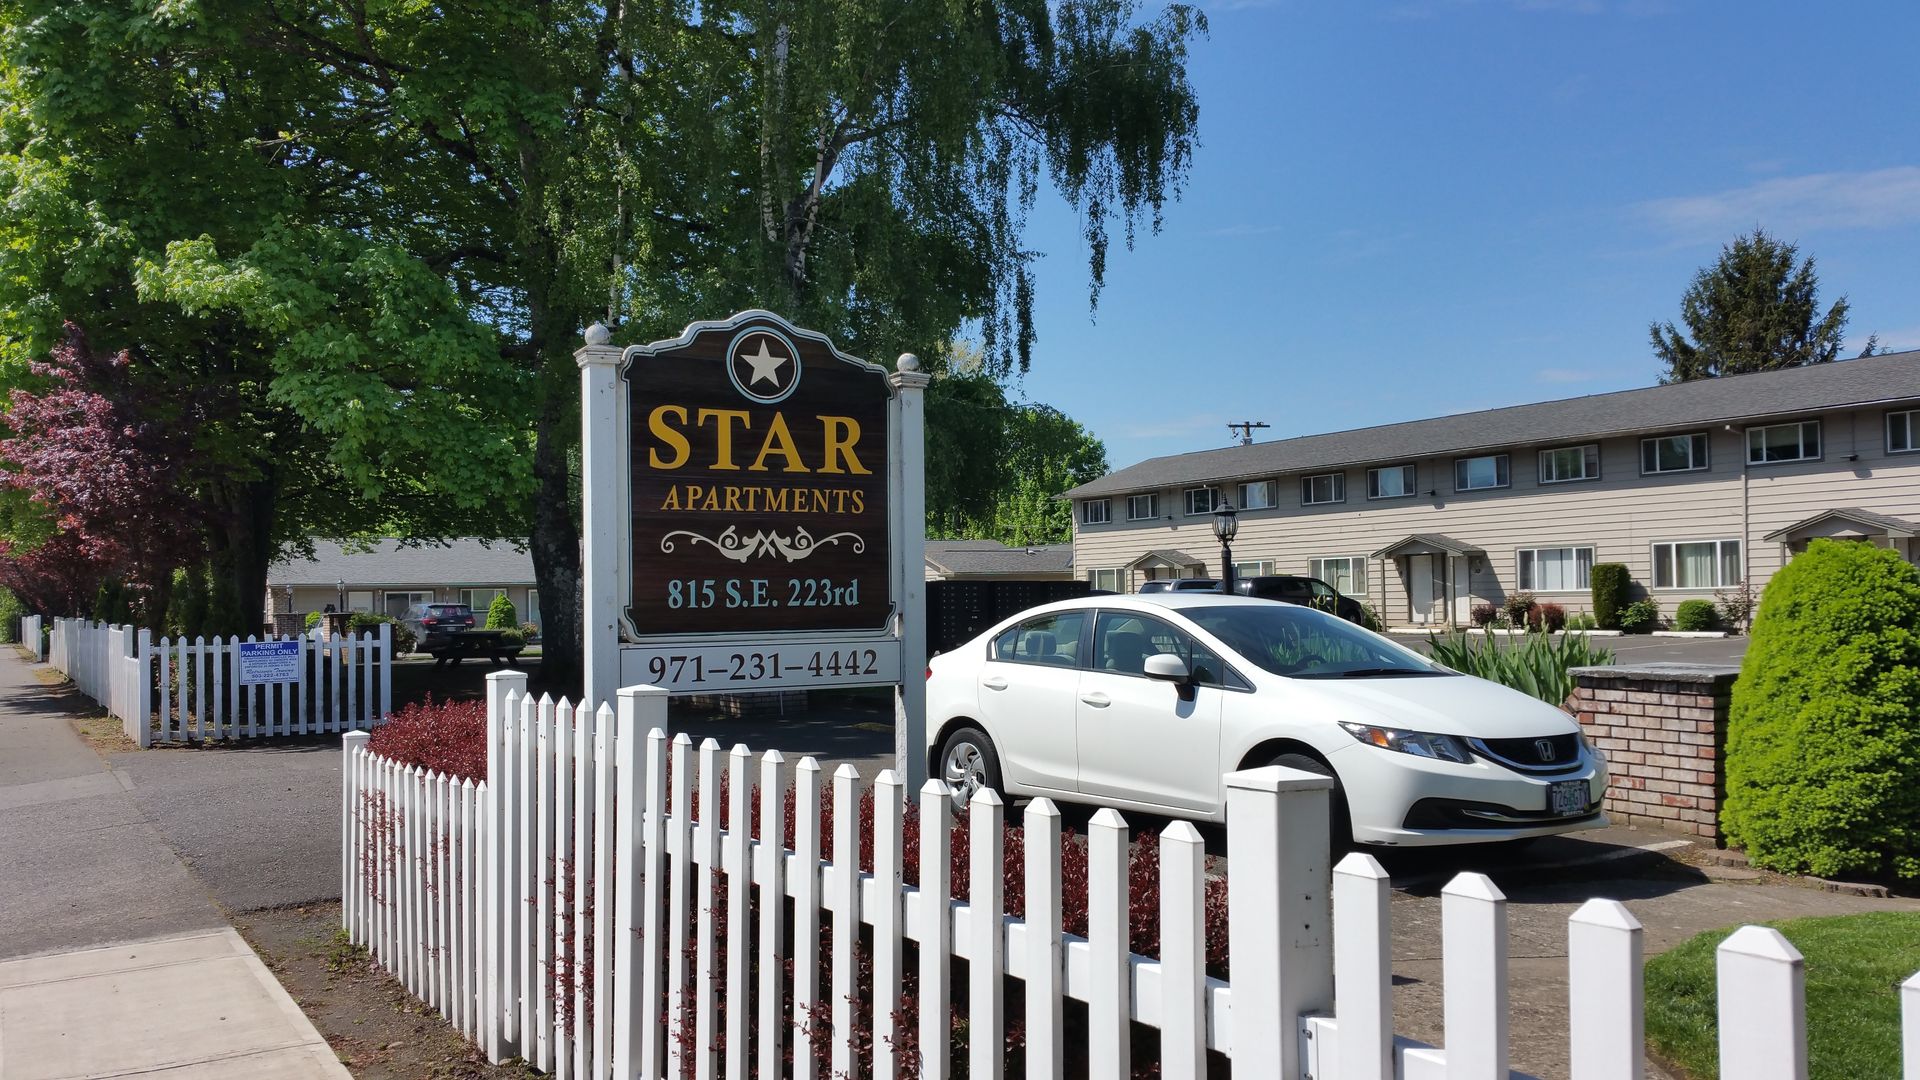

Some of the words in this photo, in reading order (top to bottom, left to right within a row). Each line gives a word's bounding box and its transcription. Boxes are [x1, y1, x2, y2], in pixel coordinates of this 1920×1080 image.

[648, 404, 873, 475] STAR
[660, 484, 865, 514] APARTMENTS
[667, 579, 716, 609] 815
[725, 579, 778, 608] S.E.
[787, 578, 859, 608] 223rd
[241, 649, 276, 657] PARKING
[648, 649, 878, 685] 971-231-4442
